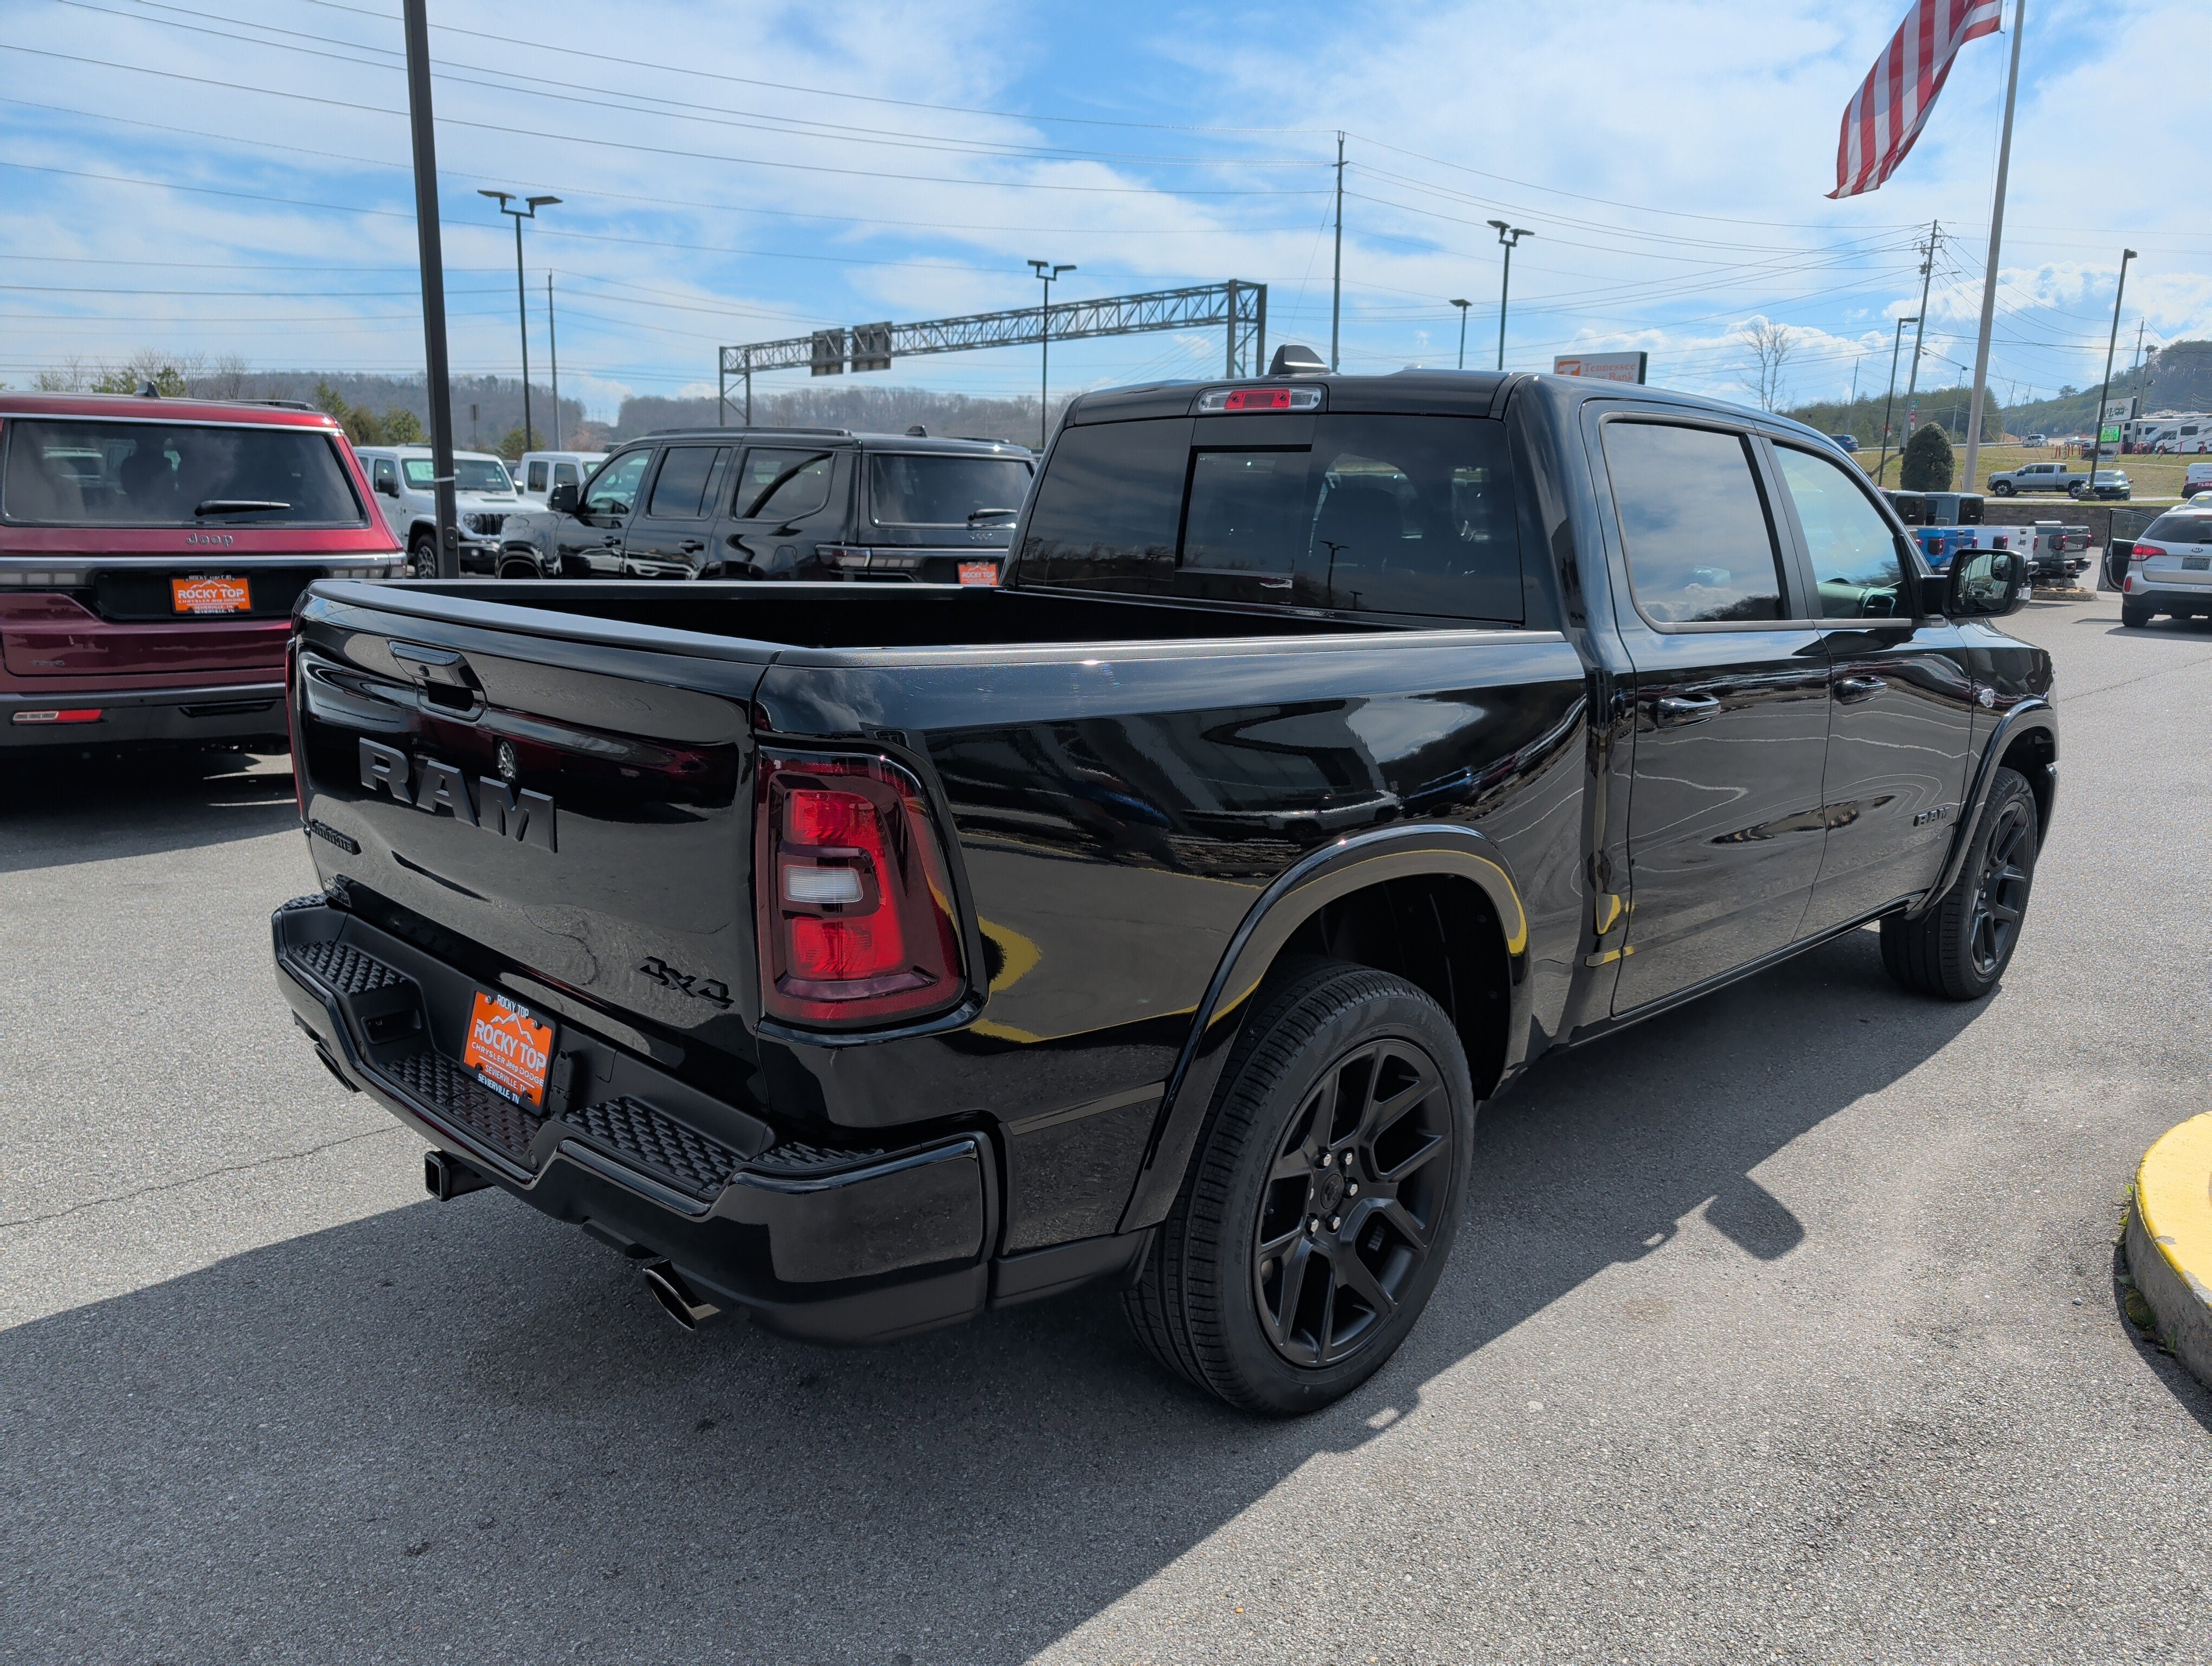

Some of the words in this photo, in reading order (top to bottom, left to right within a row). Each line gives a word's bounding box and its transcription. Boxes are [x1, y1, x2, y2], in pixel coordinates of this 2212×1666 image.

[1584, 363, 1635, 372] Tennessee
[186, 533, 233, 547] Jeep
[2018, 537, 2026, 547] Jeep
[177, 589, 217, 599] ROCKY
[219, 588, 244, 598] TOP
[359, 737, 558, 854] RAM
[1913, 806, 1950, 827] RAM
[497, 994, 516, 1013] ROCKY
[518, 1004, 529, 1018] TOP
[474, 1018, 518, 1057] ROCKY
[520, 1043, 546, 1072] TOP
[471, 1041, 506, 1064] CHRYSLER
[506, 1059, 518, 1073] Jeep
[519, 1067, 544, 1087] DODGE
[478, 1073, 511, 1100] SEVIERVILLE,
[512, 1093, 520, 1105] TN
[485, 1065, 517, 1091] SEVIERVILLE,
